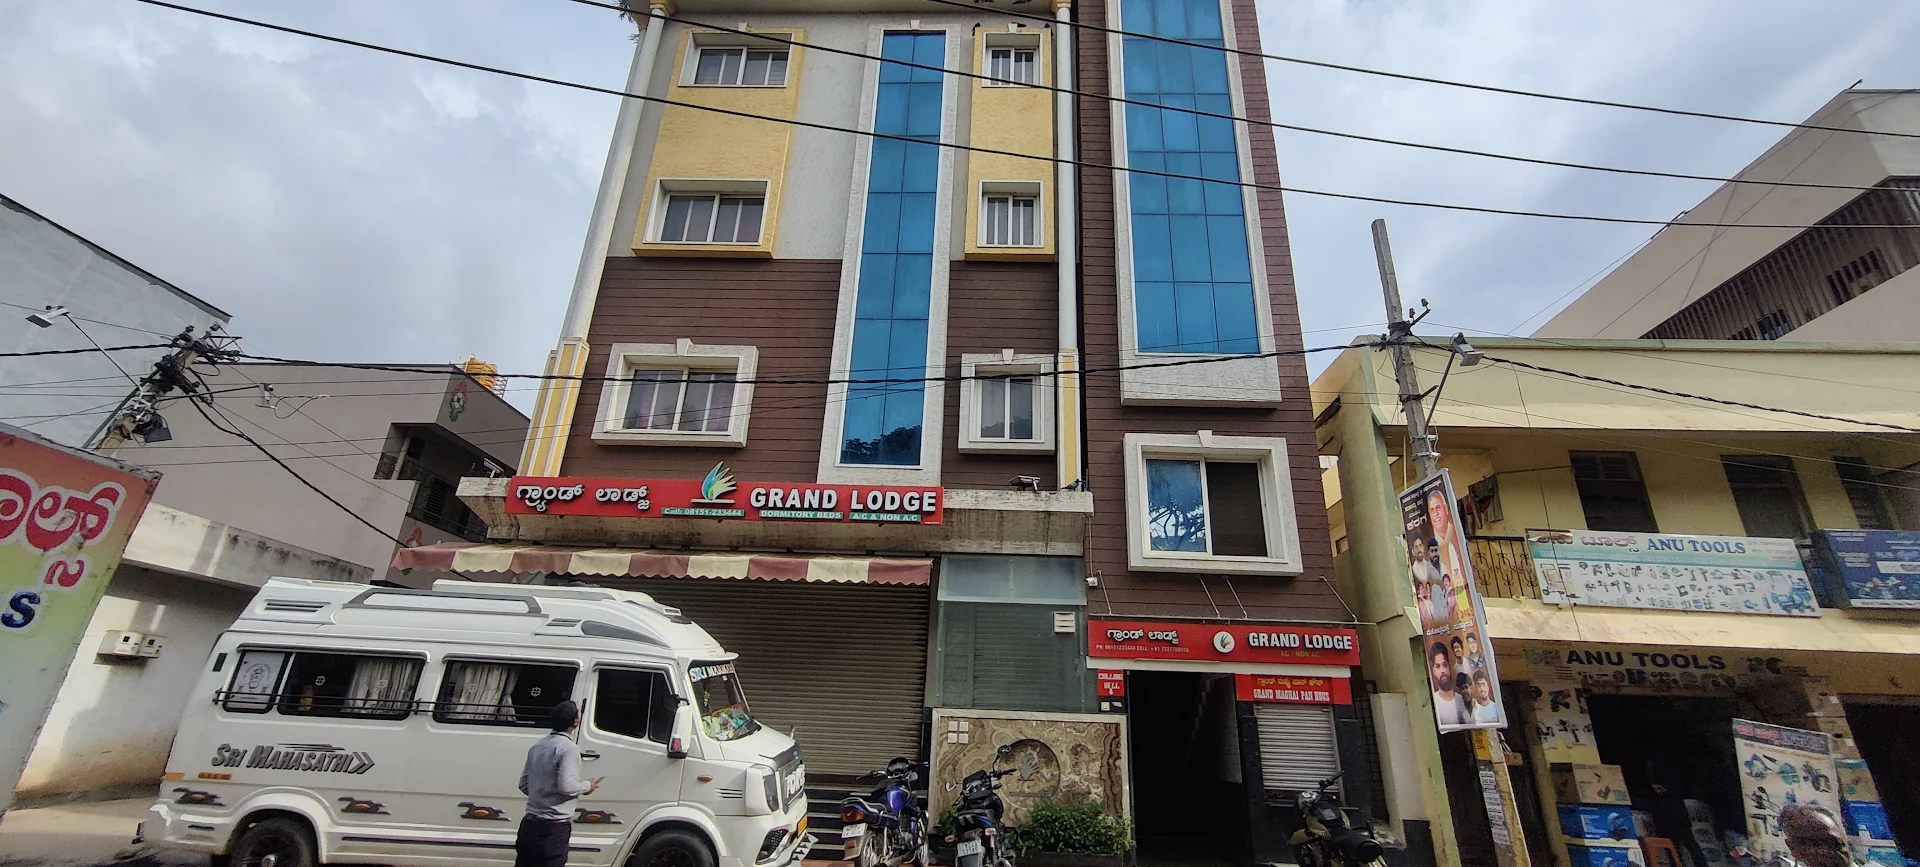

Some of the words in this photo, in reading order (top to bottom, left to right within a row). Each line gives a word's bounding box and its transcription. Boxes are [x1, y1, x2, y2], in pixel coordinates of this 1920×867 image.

[595, 486, 650, 510] ಲಾಡ್ಜ್
[750, 487, 838, 509] GRAND
[851, 489, 937, 512] LODGE
[684, 508, 741, 517] 08151-233444
[760, 510, 815, 518] DORMITORY
[816, 511, 841, 519] BEDS
[881, 513, 901, 521] NON
[1647, 538, 1684, 551] ANU
[1687, 539, 1747, 554] TOOLS
[1248, 632, 1300, 648] GRAND
[1304, 634, 1353, 650] LODGE
[1566, 650, 1624, 667] ANU
[1631, 652, 1727, 670] TOOLS
[1253, 688, 1274, 699] GRAND
[1300, 690, 1314, 701] PAN
[211, 743, 248, 768] SRI
[246, 745, 355, 774] MAHASATHI
